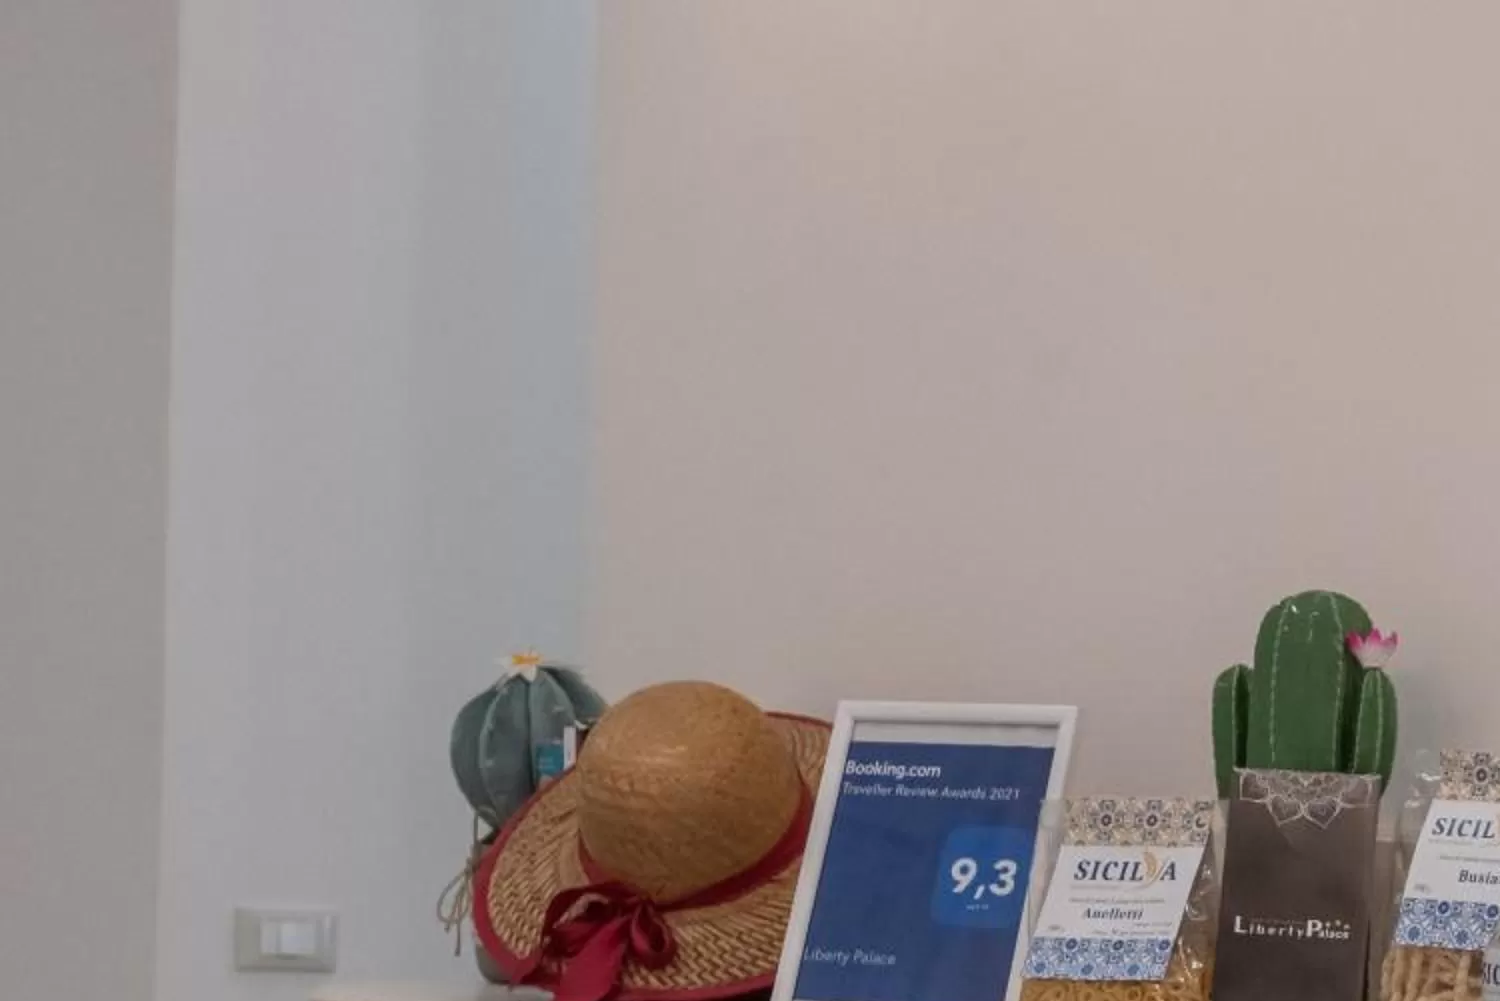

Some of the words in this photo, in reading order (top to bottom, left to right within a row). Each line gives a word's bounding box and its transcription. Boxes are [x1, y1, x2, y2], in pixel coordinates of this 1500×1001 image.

[845, 760, 942, 779] Booking.com
[843, 782, 892, 796] Traveller
[895, 784, 938, 797] Review
[941, 786, 985, 799] Awards
[989, 788, 1020, 800] 2021
[951, 857, 1017, 900] 9,3
[803, 947, 850, 966] Liberty
[853, 949, 897, 966] Palace
